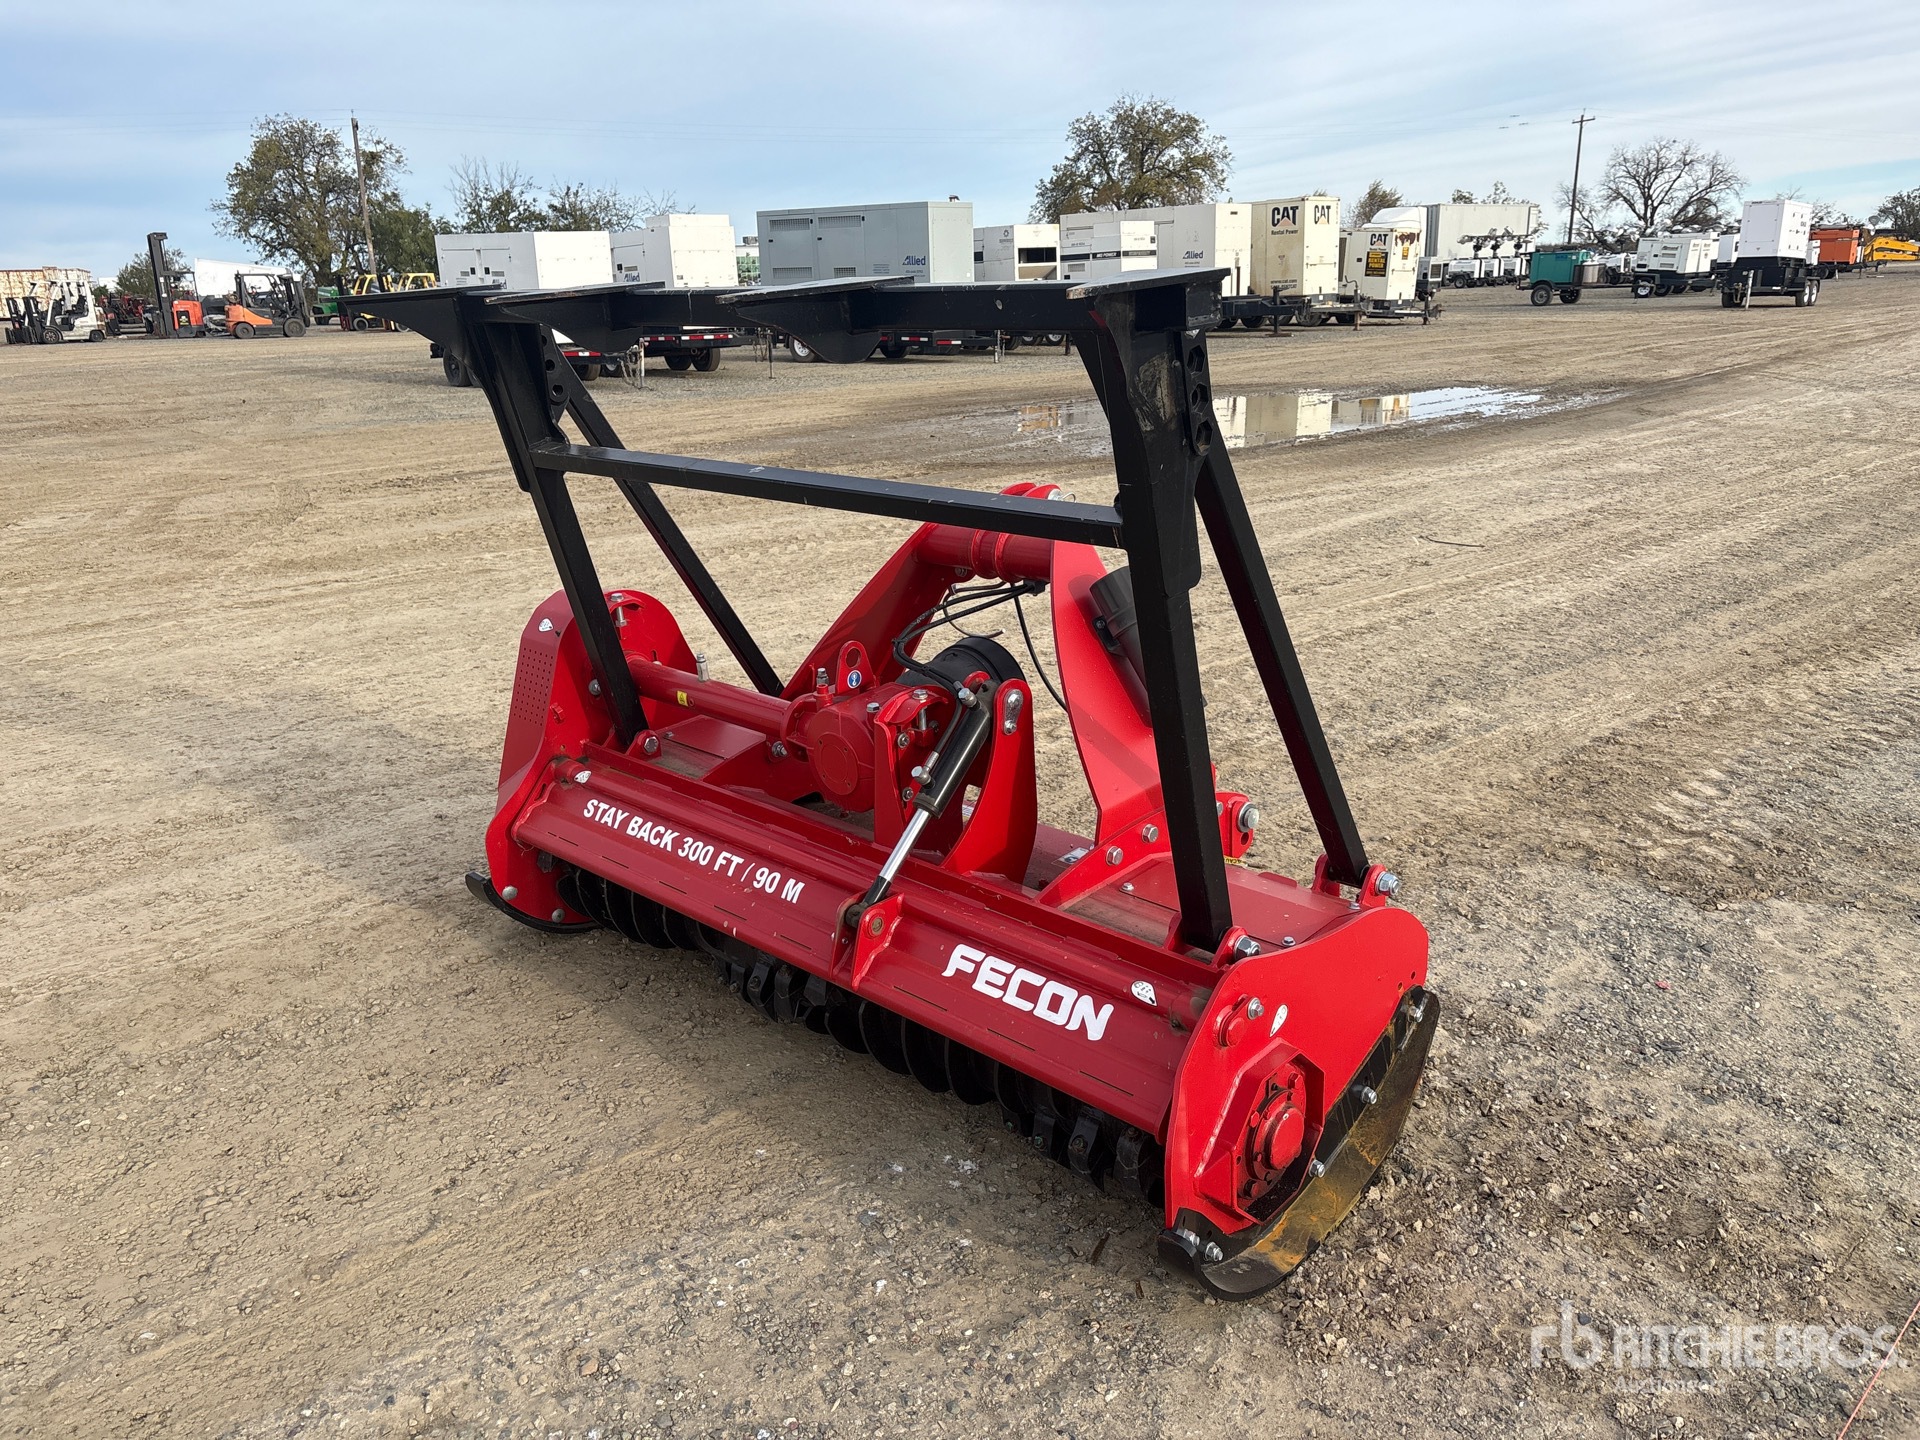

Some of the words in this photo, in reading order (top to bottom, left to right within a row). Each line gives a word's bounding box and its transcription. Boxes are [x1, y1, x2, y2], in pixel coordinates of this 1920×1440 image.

[1271, 205, 1299, 227] CAT
[1314, 204, 1331, 225] CAT
[1370, 233, 1389, 246] CAT
[902, 255, 926, 265] Allied
[1182, 251, 1204, 259] Allied
[583, 799, 630, 830] STAY
[626, 816, 680, 852] BACK
[678, 837, 714, 866] 300
[714, 851, 744, 877] FT
[741, 862, 755, 882] /
[753, 867, 781, 893] 90
[781, 878, 805, 904] M
[941, 943, 1115, 1041] FECON
